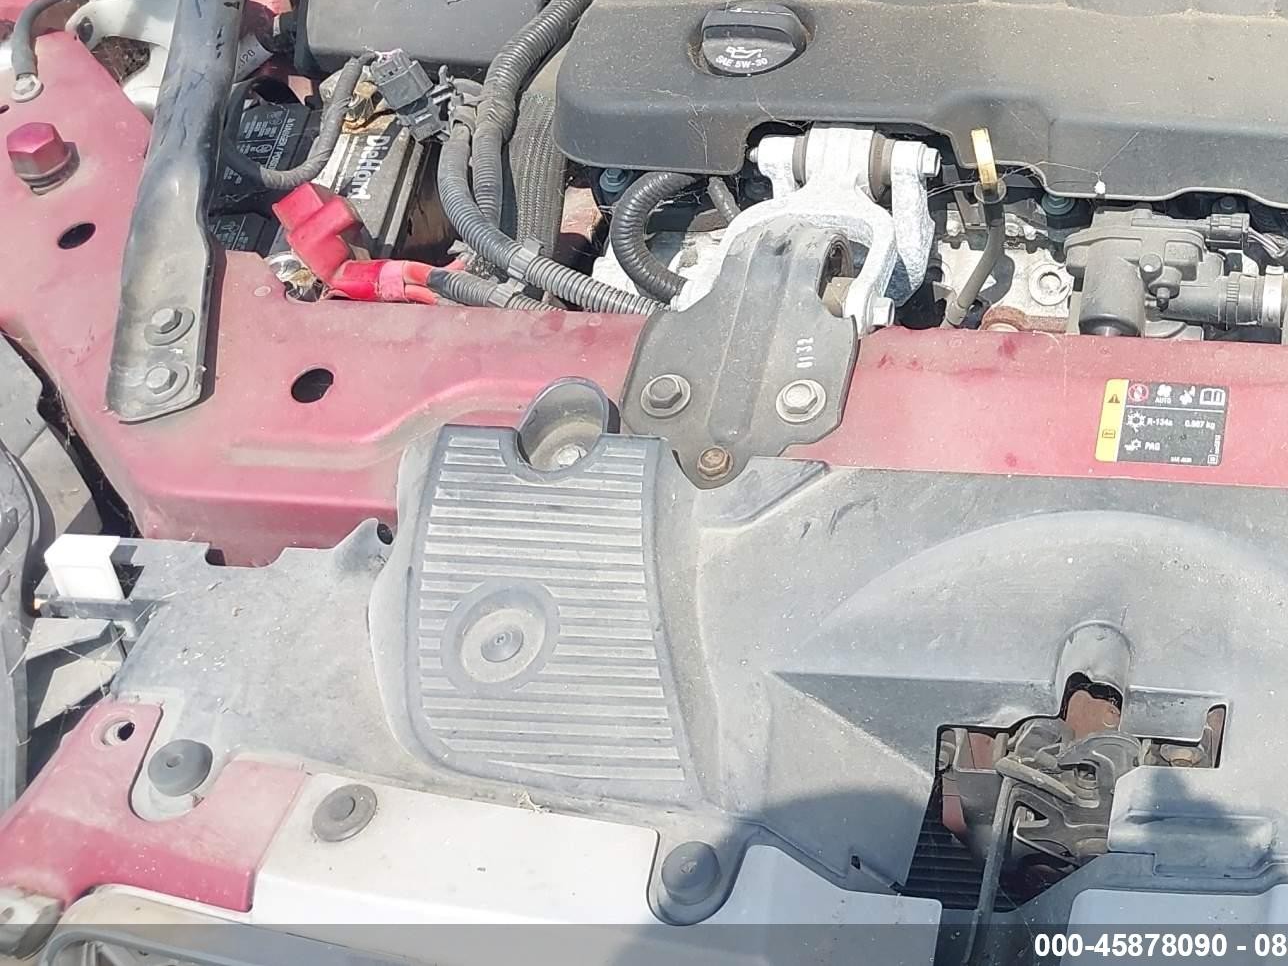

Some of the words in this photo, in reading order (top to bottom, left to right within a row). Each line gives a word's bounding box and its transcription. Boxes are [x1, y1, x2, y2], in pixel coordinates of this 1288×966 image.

[715, 54, 733, 68] SAE
[734, 57, 769, 69] 5W-30
[347, 134, 391, 200] DieHard
